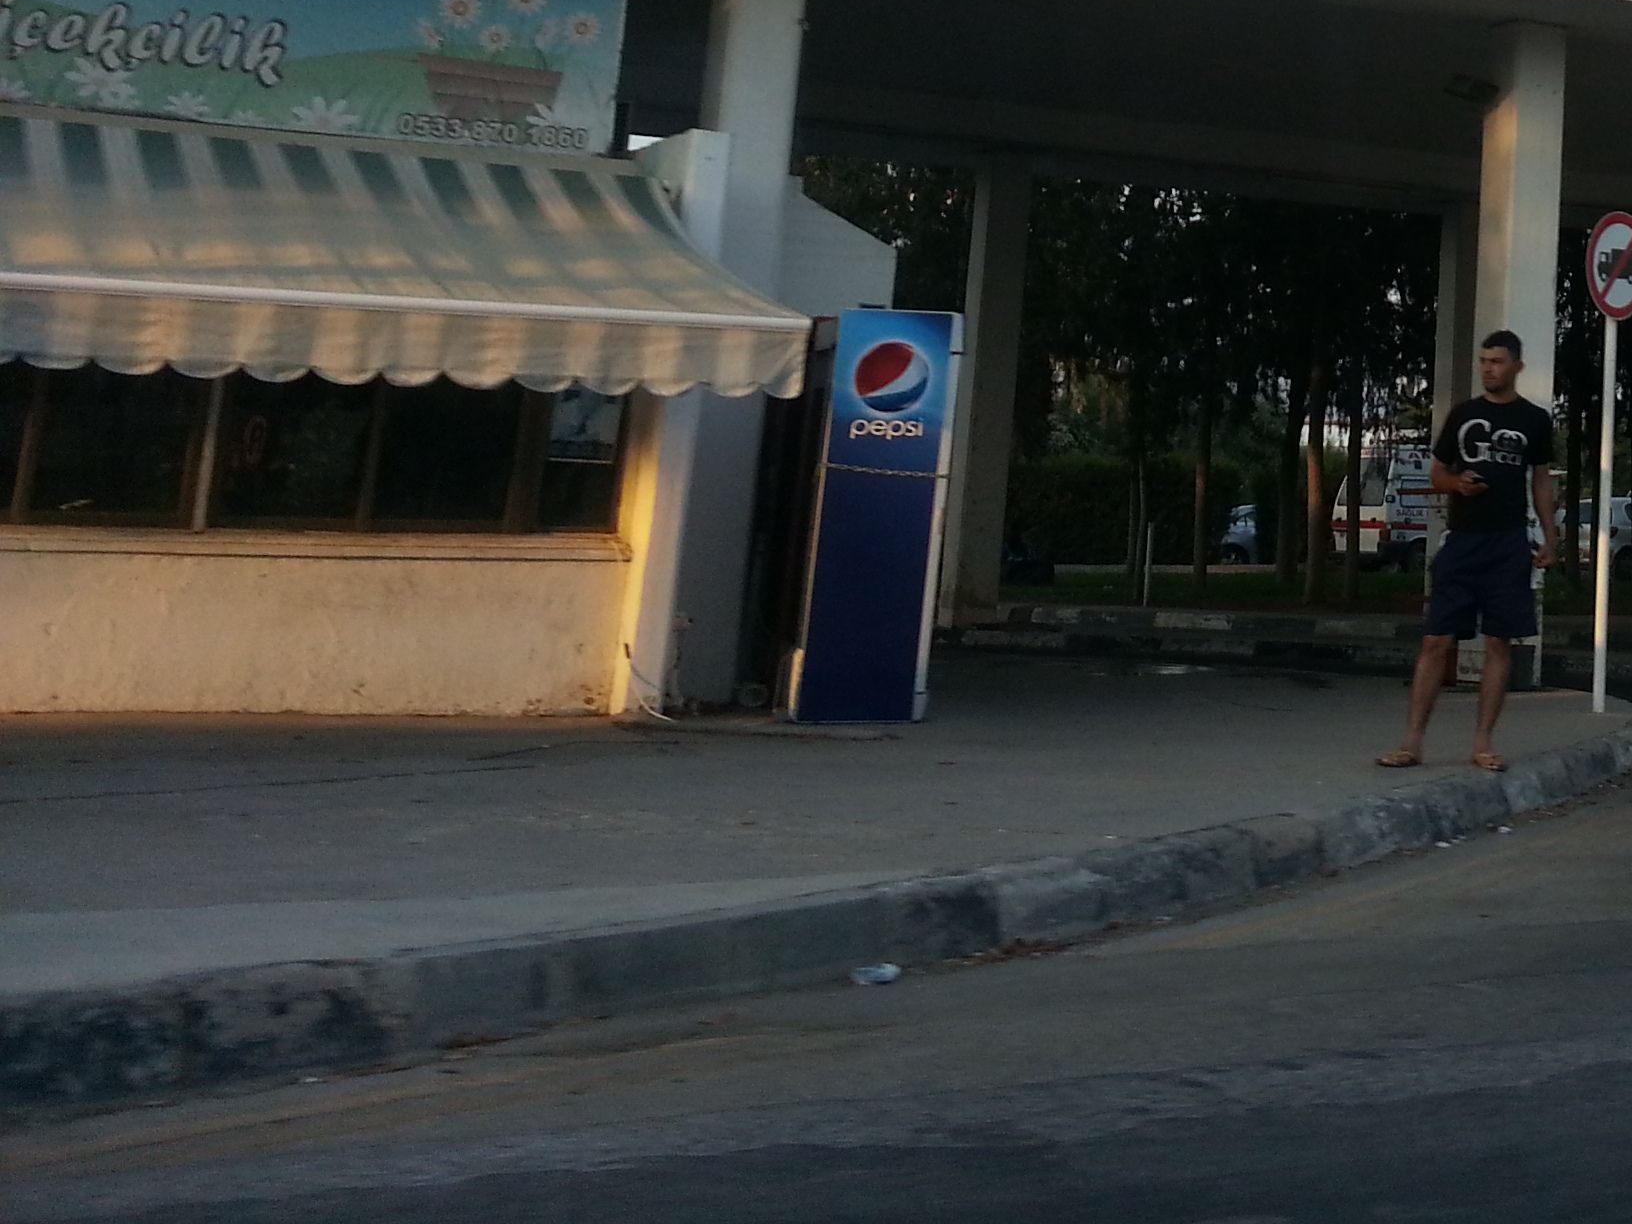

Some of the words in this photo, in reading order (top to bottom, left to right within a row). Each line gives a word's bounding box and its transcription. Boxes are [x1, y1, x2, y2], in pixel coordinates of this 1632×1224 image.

[399, 113, 462, 139] 0533
[468, 120, 518, 143] 870
[849, 418, 924, 439] pepsi
